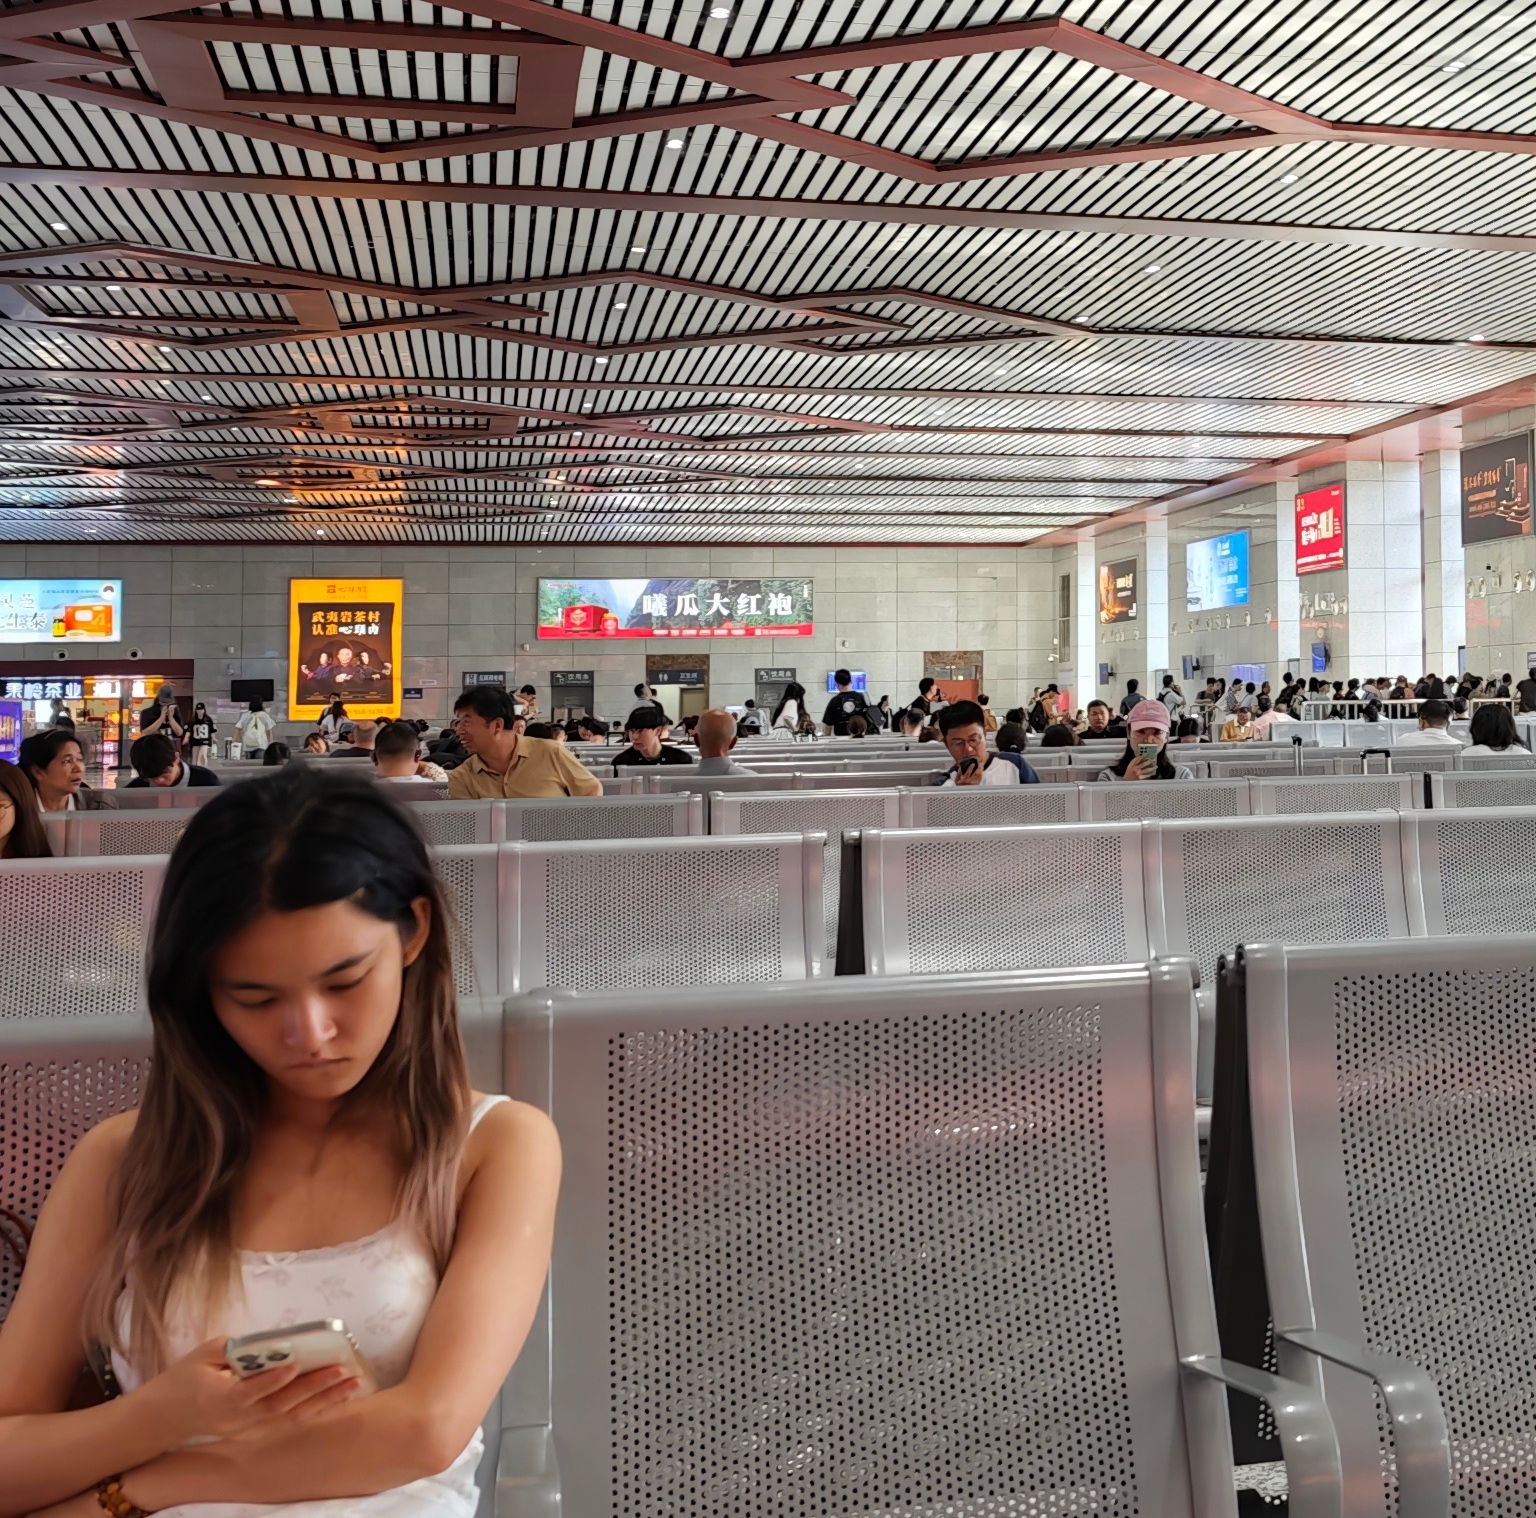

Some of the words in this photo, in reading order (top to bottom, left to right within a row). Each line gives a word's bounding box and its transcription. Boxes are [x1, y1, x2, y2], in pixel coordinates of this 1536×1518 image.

[643, 593, 793, 616] 曦瓜大红袍
[311, 611, 381, 623] 武夷岩茶村
[193, 724, 209, 739] 09
